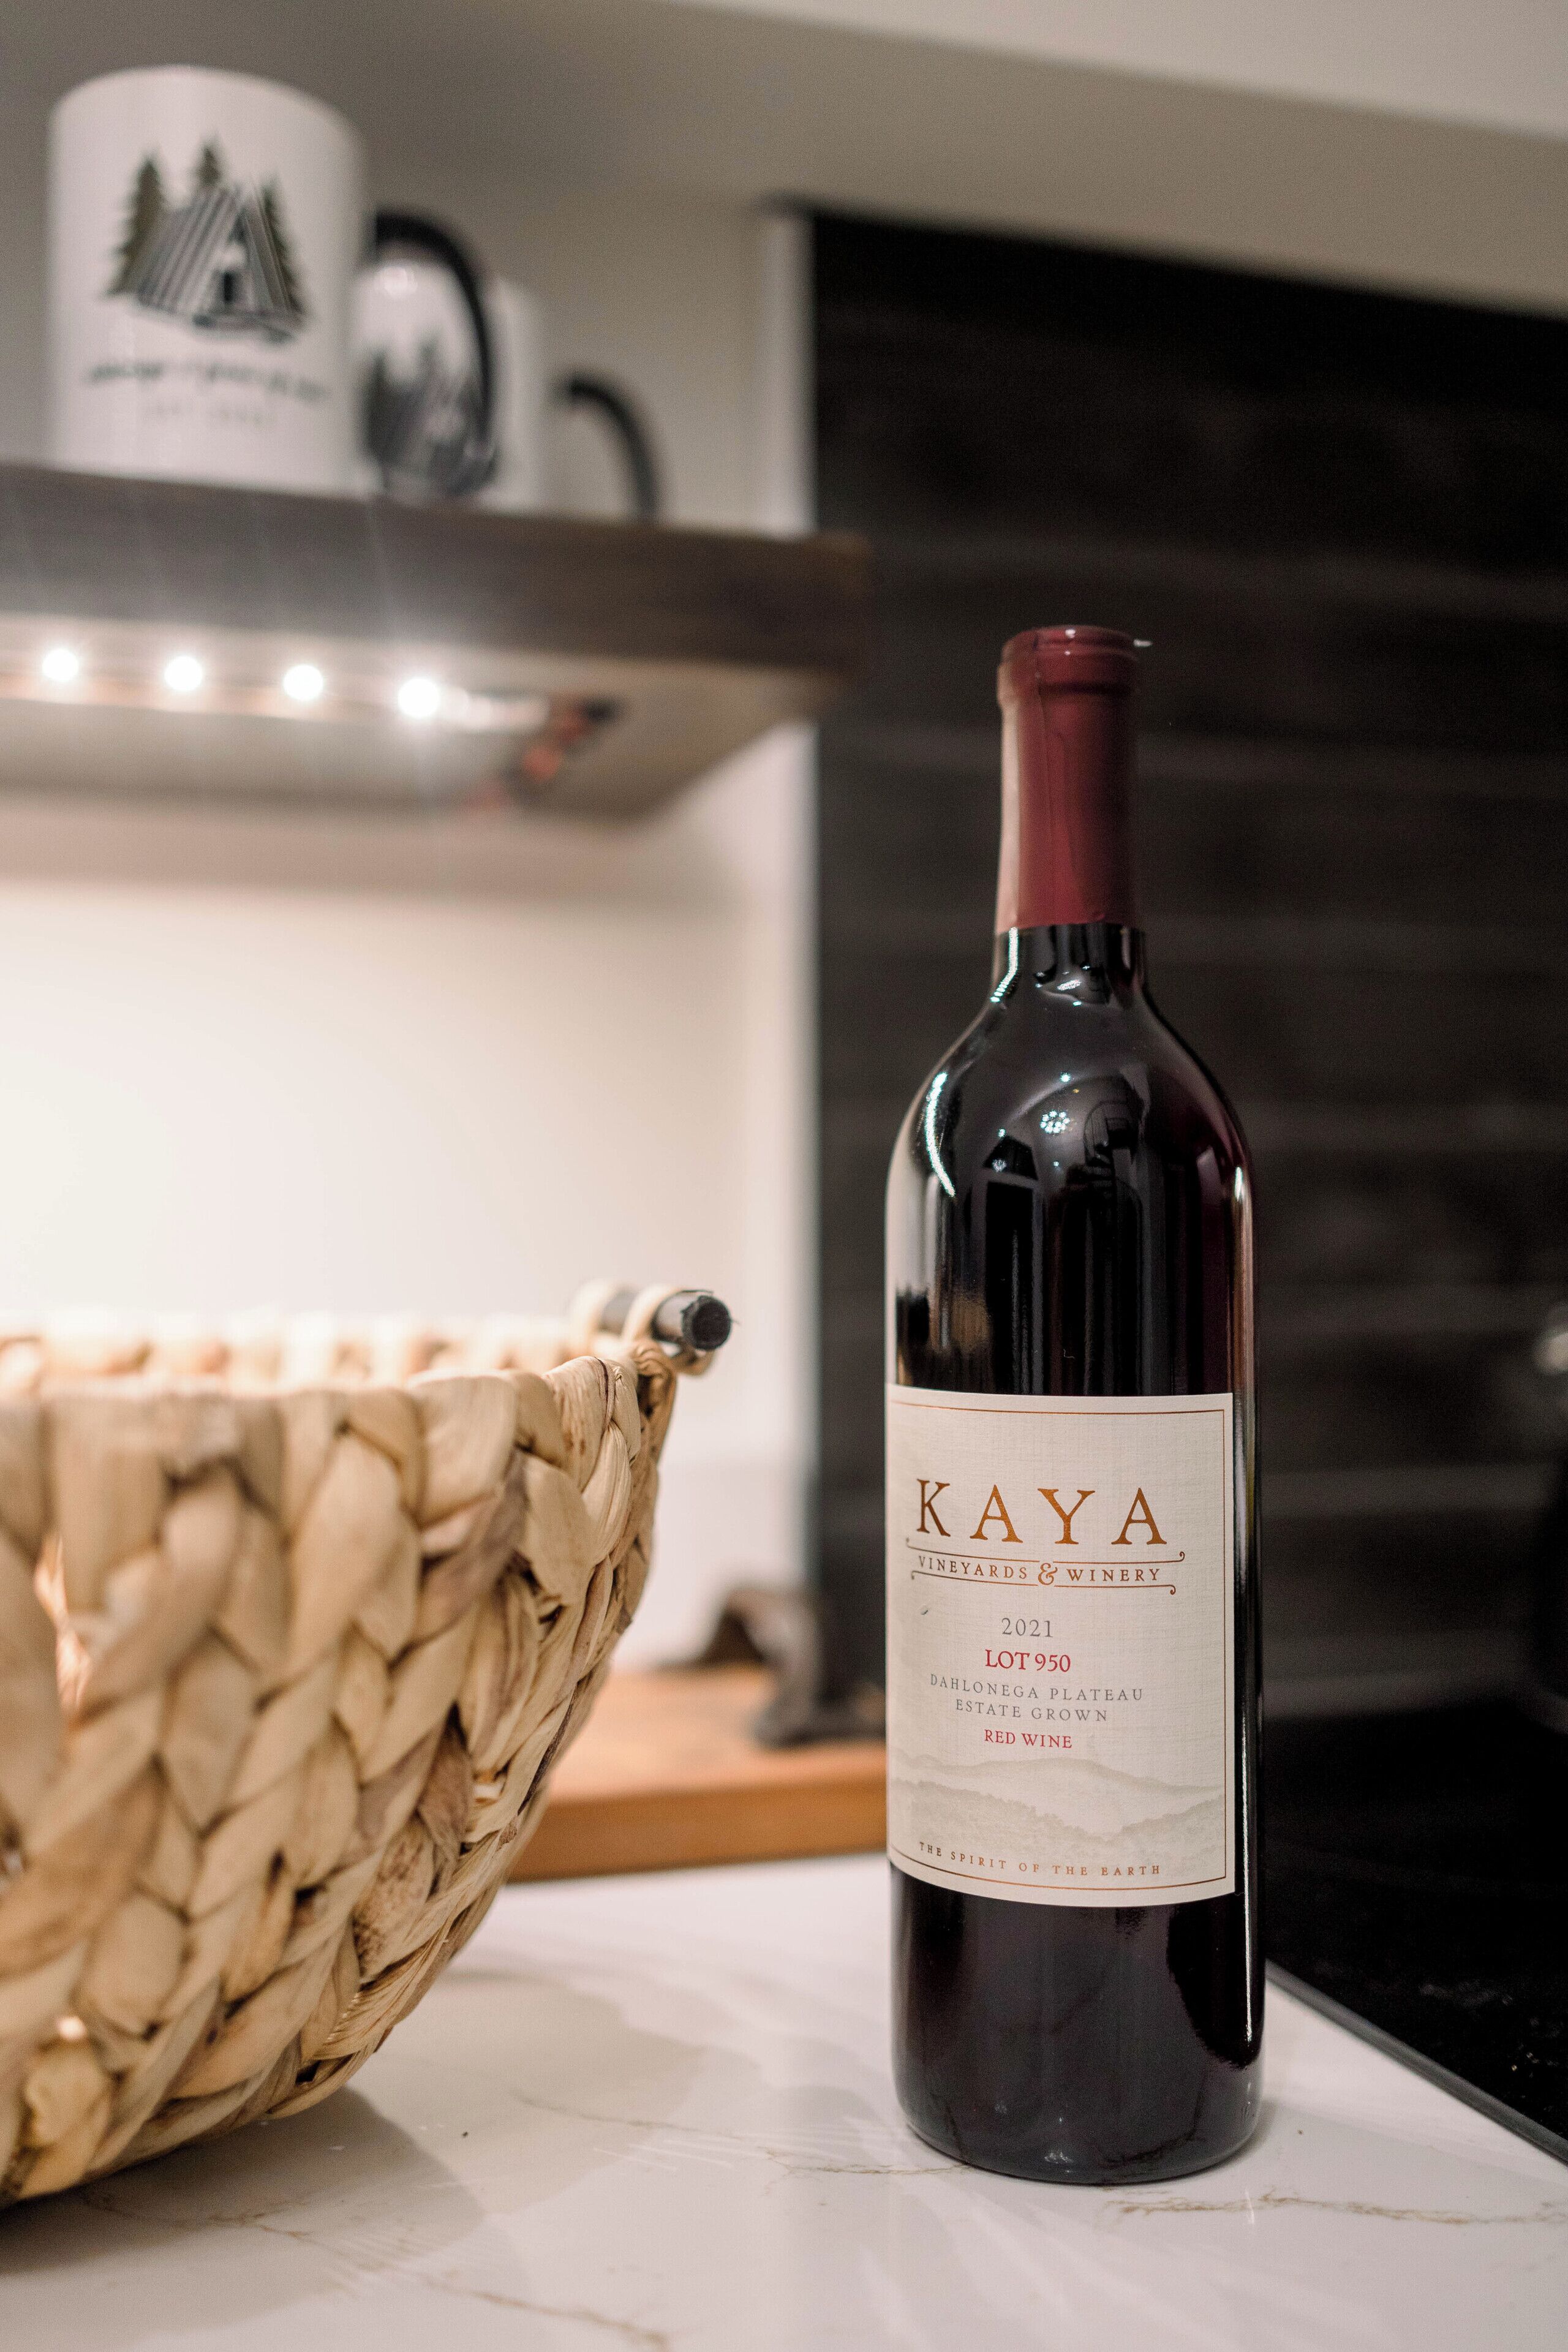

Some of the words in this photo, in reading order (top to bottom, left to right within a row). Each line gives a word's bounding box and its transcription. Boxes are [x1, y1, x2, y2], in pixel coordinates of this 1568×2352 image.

[916, 1478, 1167, 1546] KAYA
[918, 1555, 1028, 1580] VINEYARDS
[1037, 1562, 1058, 1586] &
[1066, 1567, 1161, 1583] WINERY
[1001, 1617, 1054, 1638] 2021
[984, 1649, 1030, 1672] LOT
[1034, 1653, 1071, 1673] 950
[930, 1673, 1039, 1700] DAHLONEGA
[1049, 1687, 1144, 1702] PLATEAU
[955, 1698, 1022, 1719] ESTATE
[1030, 1707, 1109, 1722] GROWN
[983, 1729, 1016, 1745] RED
[1021, 1732, 1072, 1749] WINE
[919, 1841, 943, 1857] THE
[950, 1850, 1006, 1870] SPIRIT
[1018, 1861, 1039, 1873] OF
[1052, 1864, 1088, 1877] THE
[1100, 1865, 1161, 1877] EARTH
